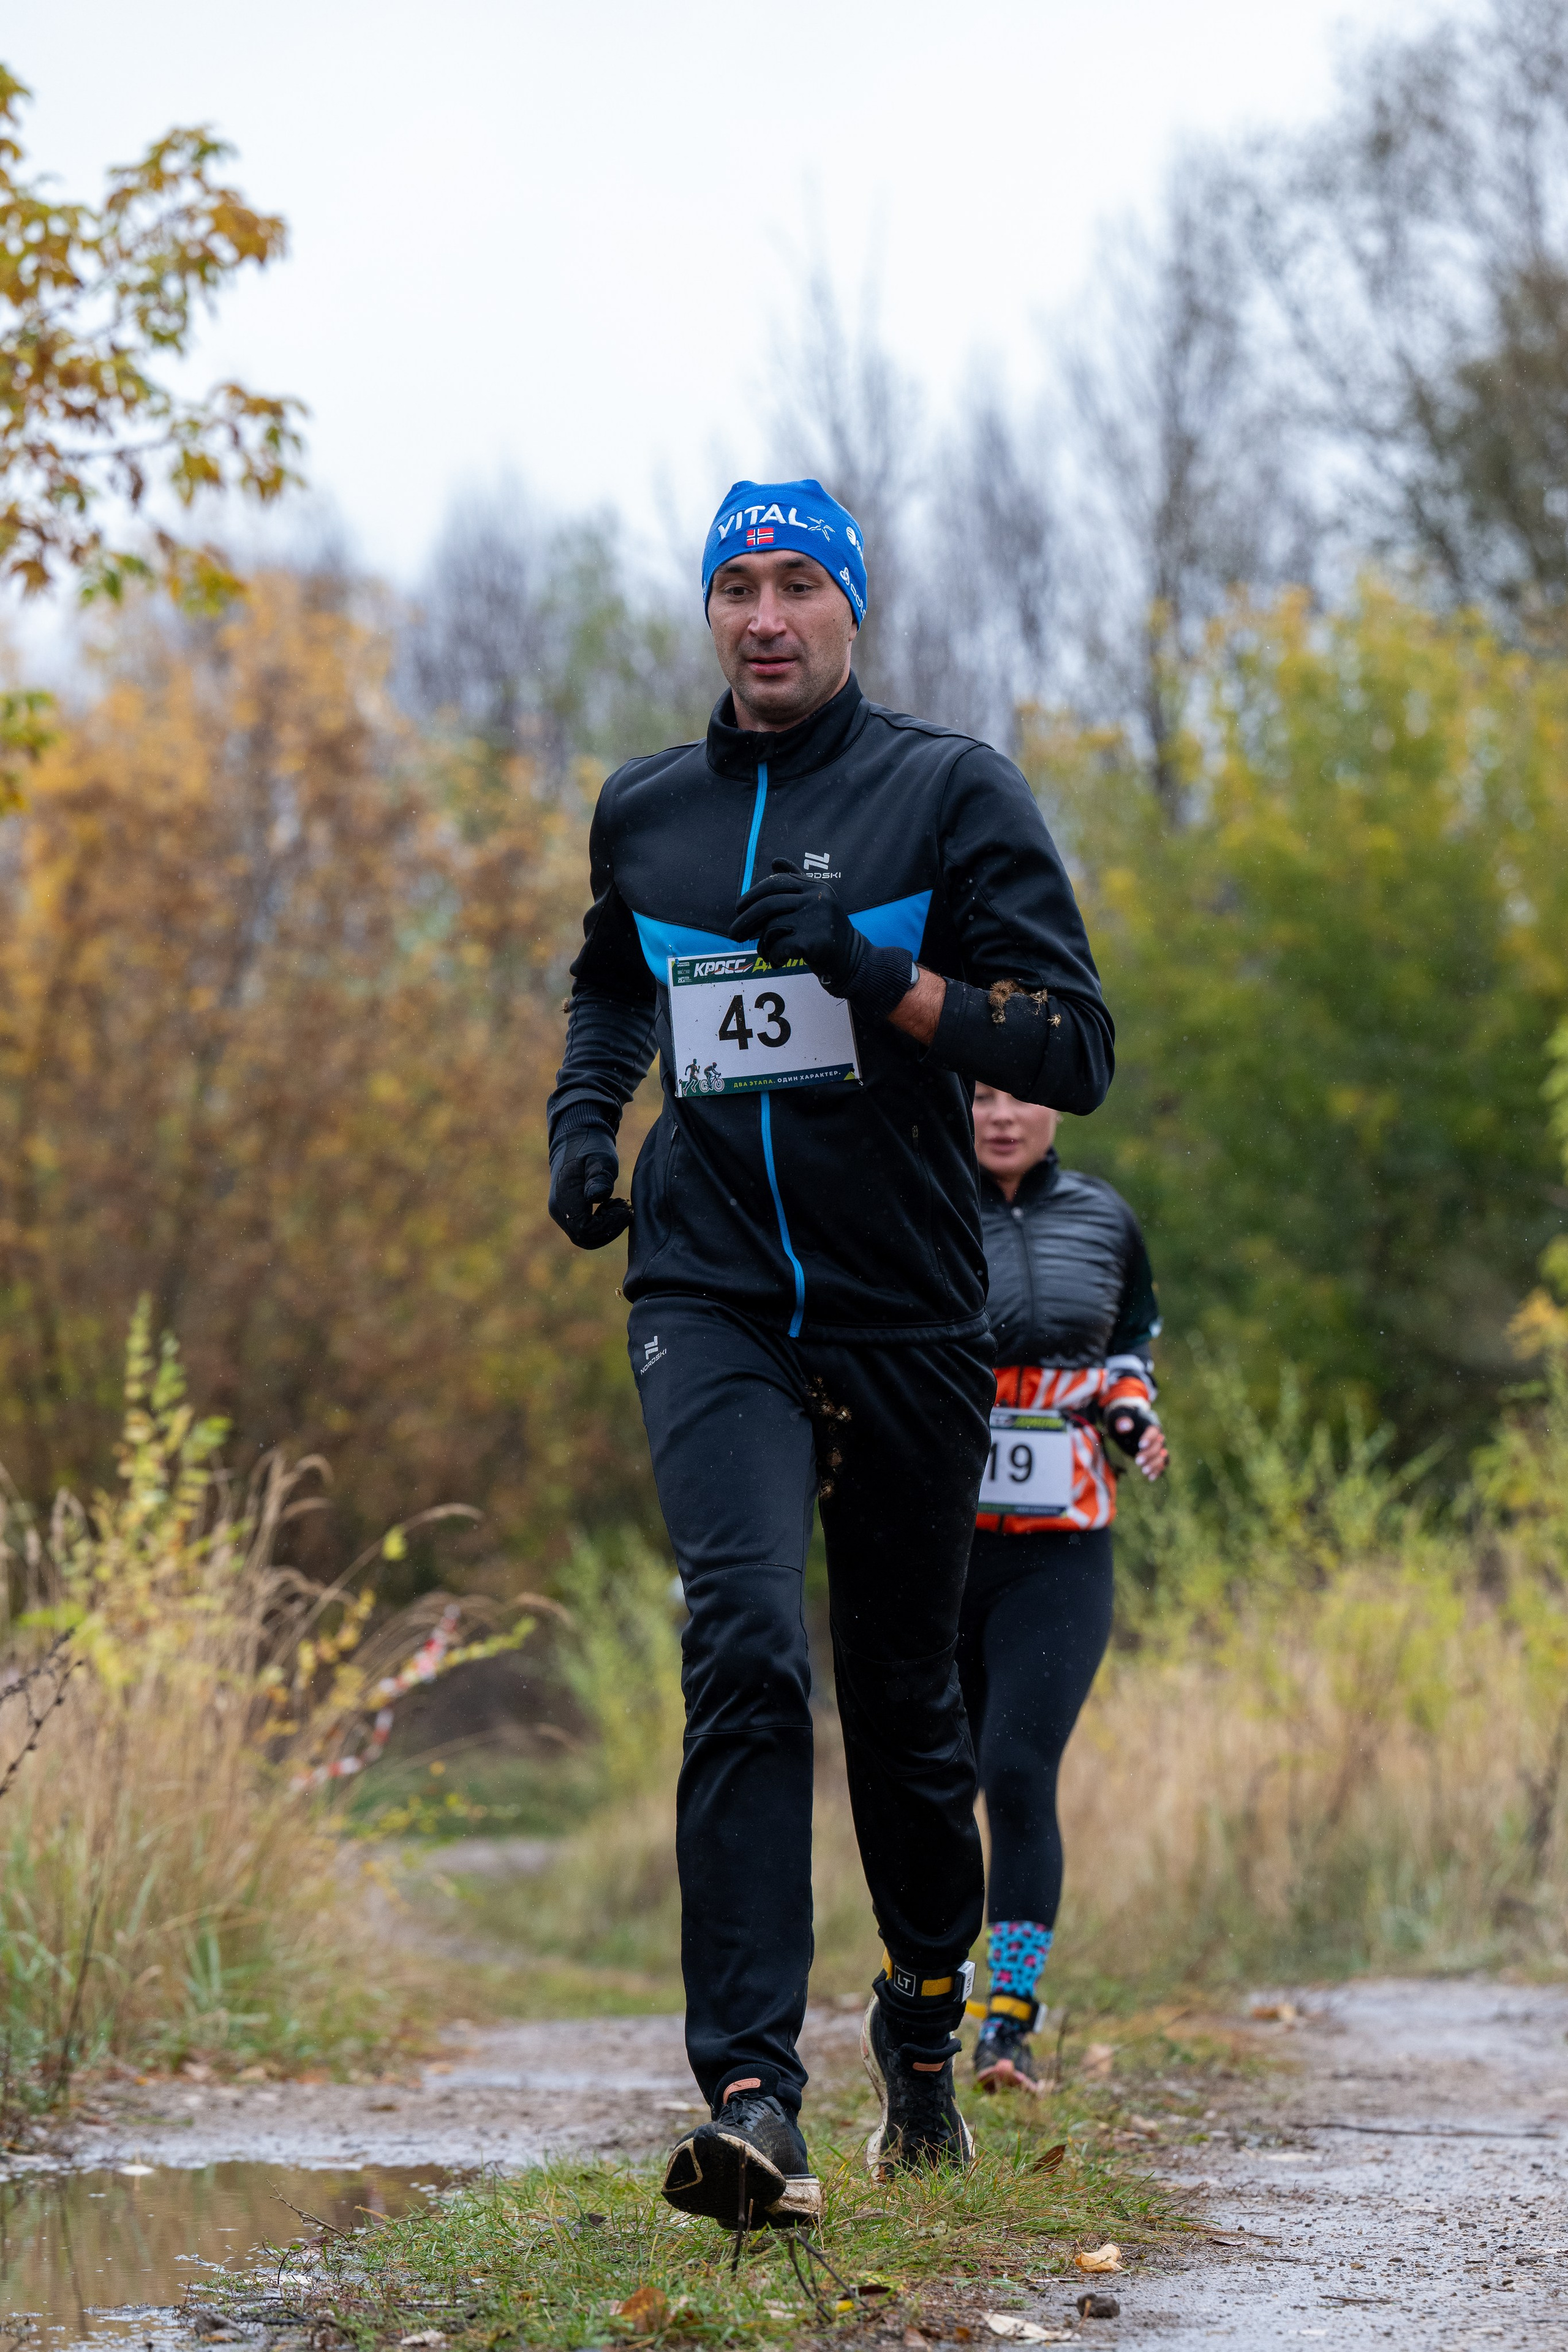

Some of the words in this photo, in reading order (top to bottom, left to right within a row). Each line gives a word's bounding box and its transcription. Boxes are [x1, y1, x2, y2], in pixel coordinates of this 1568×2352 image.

[717, 503, 808, 538] VITAL
[694, 959, 748, 977] КРОСС
[718, 992, 791, 1050] 43
[640, 1349, 667, 1375] NORDSKI
[989, 1442, 1033, 1483] 19
[897, 1974, 911, 1989] LT
